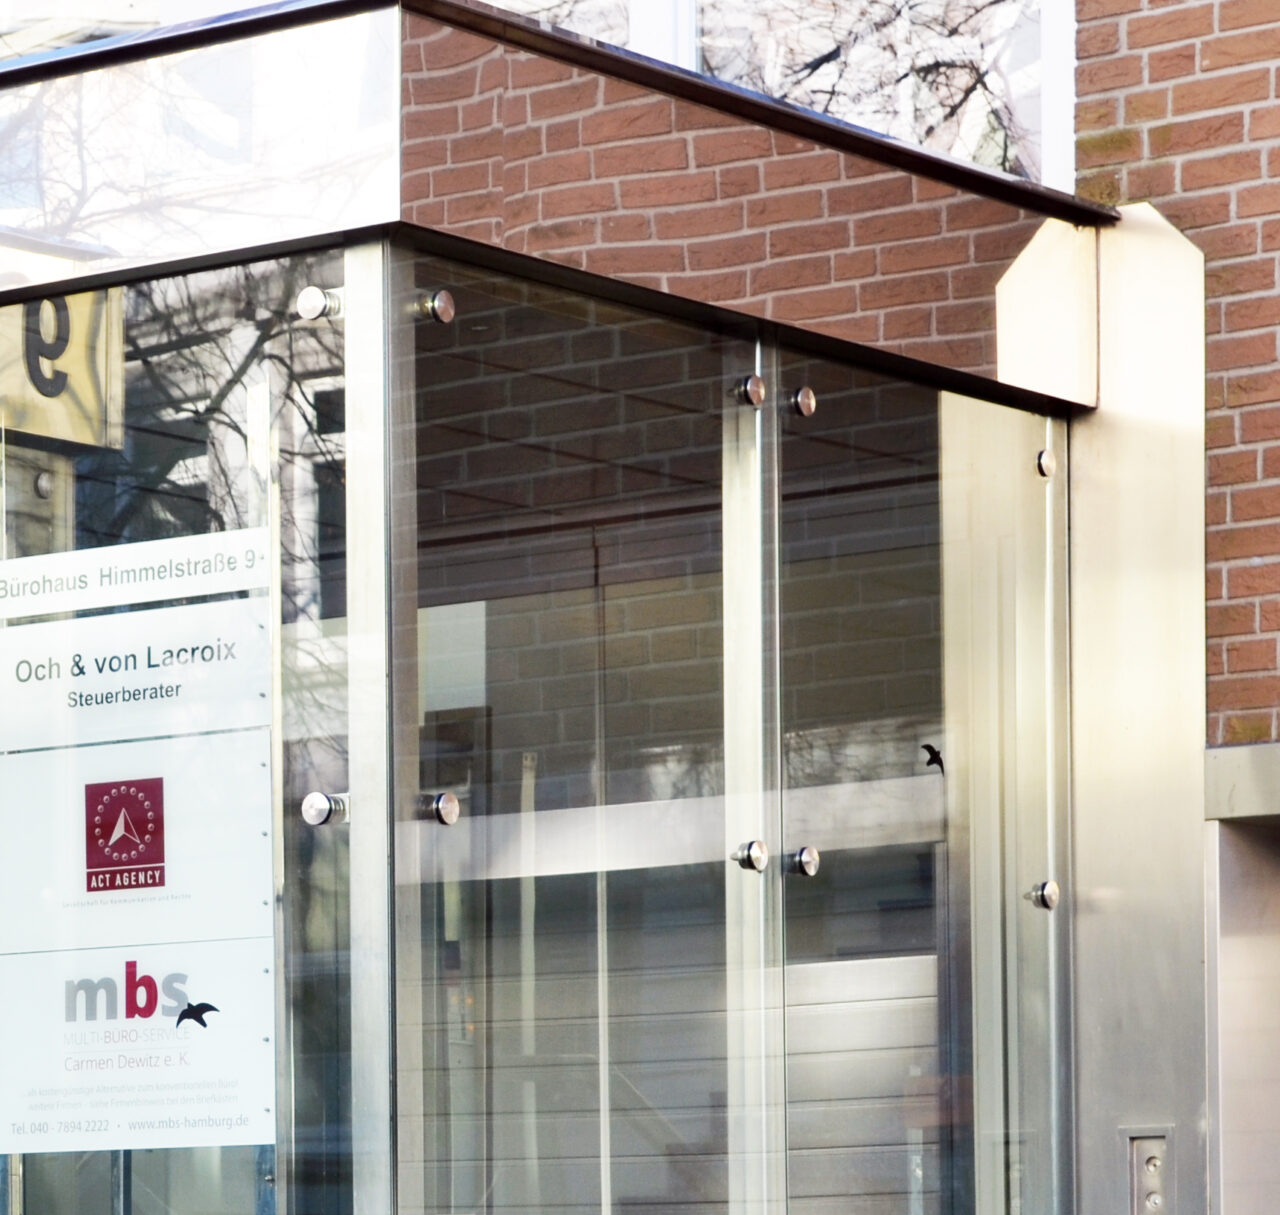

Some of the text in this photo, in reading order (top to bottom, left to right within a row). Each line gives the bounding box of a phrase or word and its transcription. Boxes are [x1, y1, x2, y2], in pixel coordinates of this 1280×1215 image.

[99, 553, 238, 587] Himmelstraße
[244, 549, 257, 569] 9
[15, 638, 238, 683] Och & von Lacroix
[67, 682, 182, 708] Steuerberater
[90, 870, 161, 889] ACT AGENCY
[65, 961, 189, 1022] mbs
[63, 1026, 191, 1046] MULTI-BÜRO-SERVICE
[64, 1057, 114, 1072] Carmen
[118, 1054, 160, 1069] Dewitz
[11, 1122, 28, 1135] Tel.
[30, 1121, 49, 1134] 040
[57, 1121, 82, 1133] 7894
[85, 1119, 109, 1132] 2222
[128, 1114, 249, 1132] www.mbs-hamburg.de
